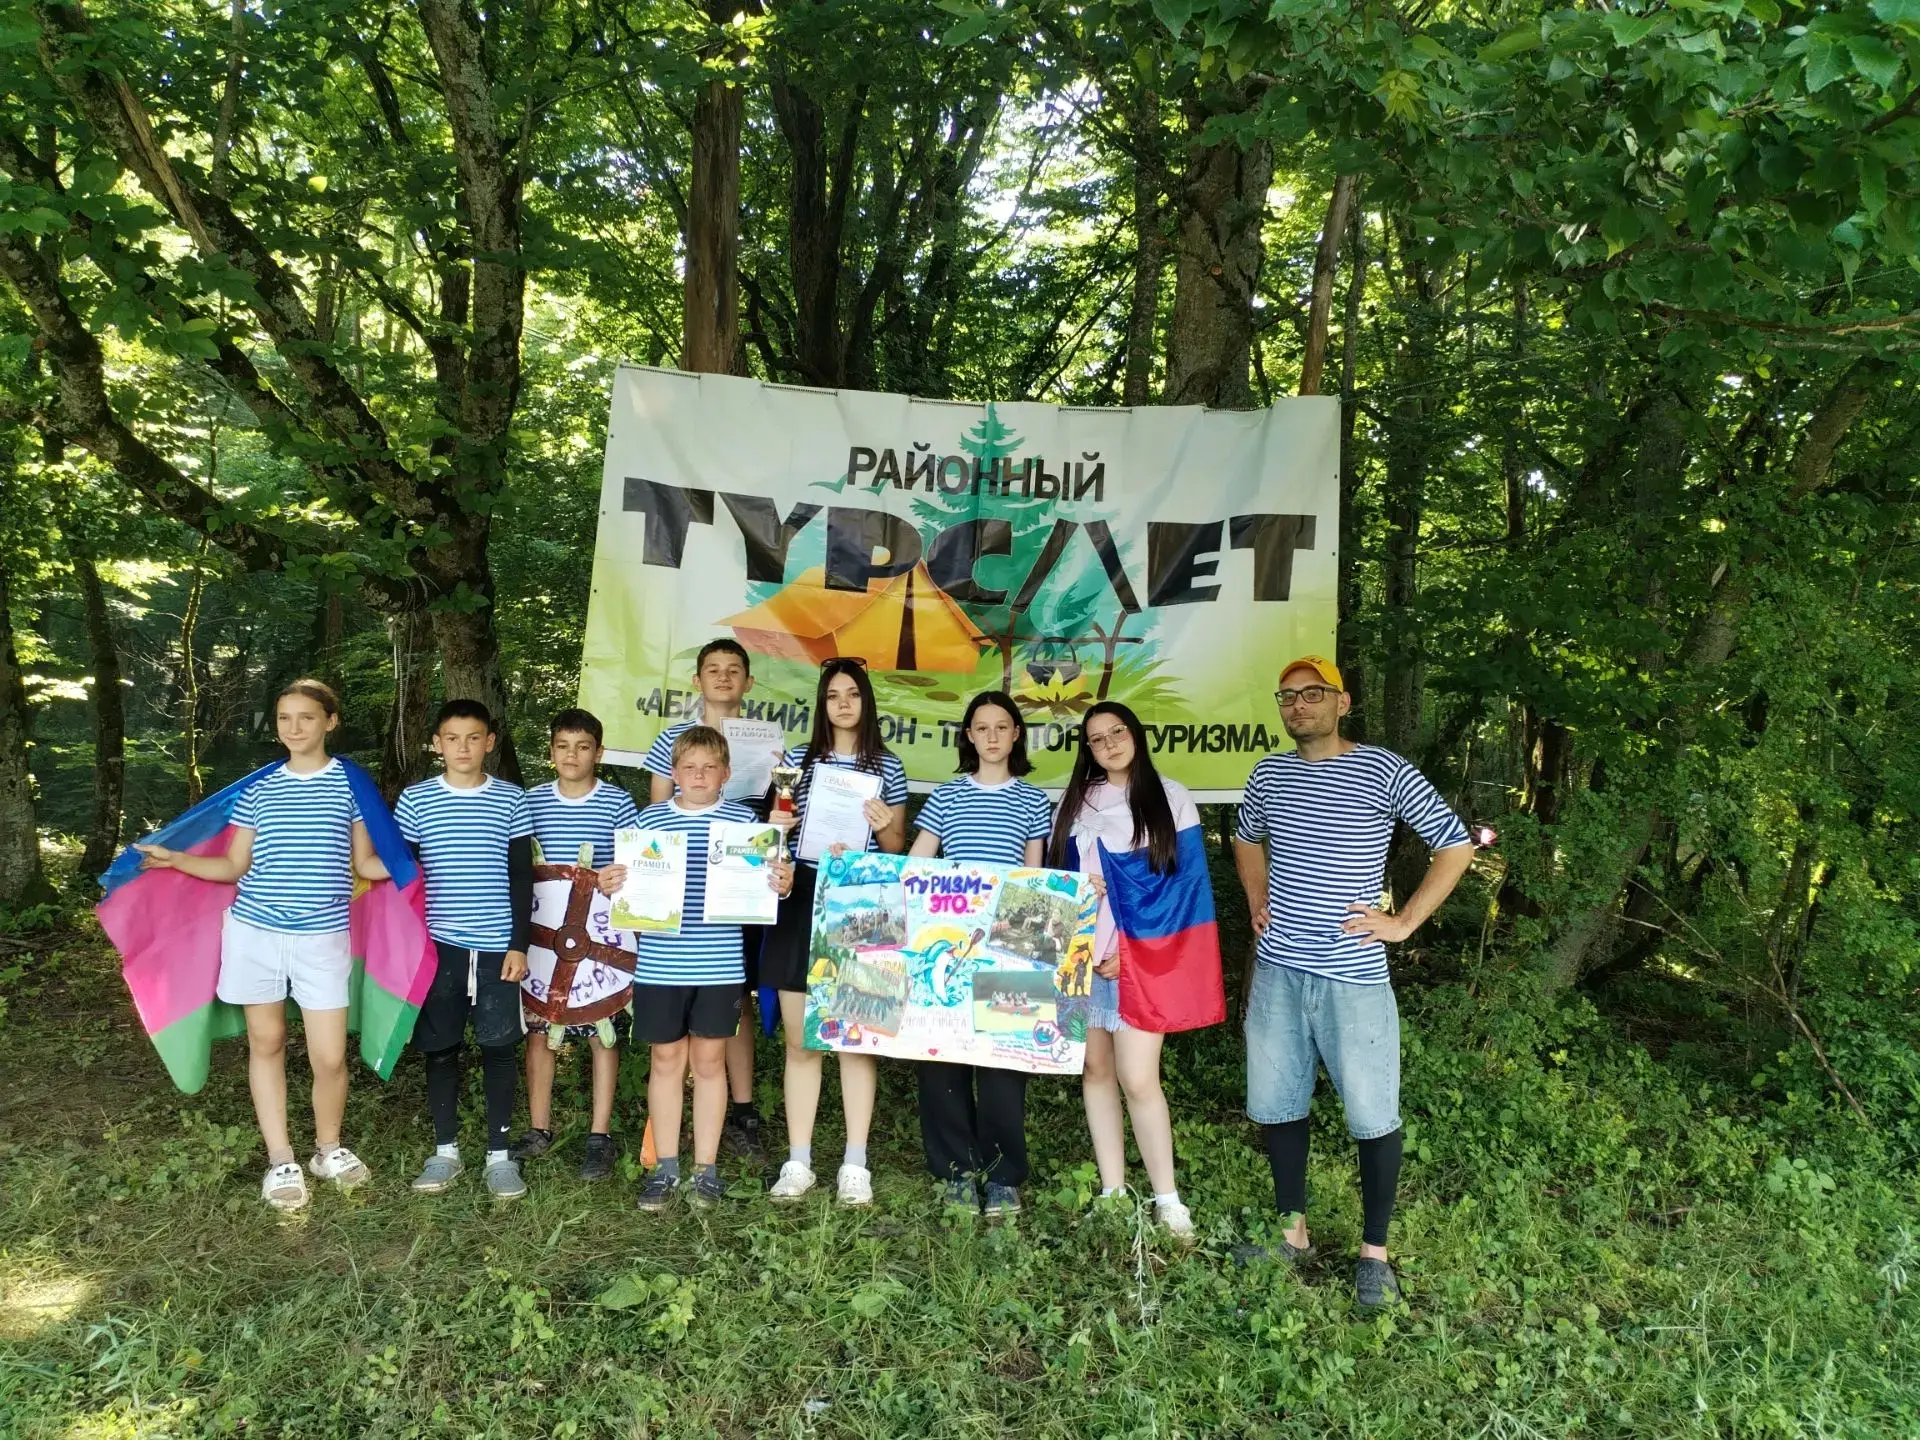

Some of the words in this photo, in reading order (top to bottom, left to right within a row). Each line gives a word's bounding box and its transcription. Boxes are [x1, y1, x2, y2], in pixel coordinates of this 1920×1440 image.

[846, 441, 1106, 503] РАЙОННЫЙ
[622, 476, 1318, 615] ТУРСЛЕТ
[632, 859, 671, 870] ГРАМОТА
